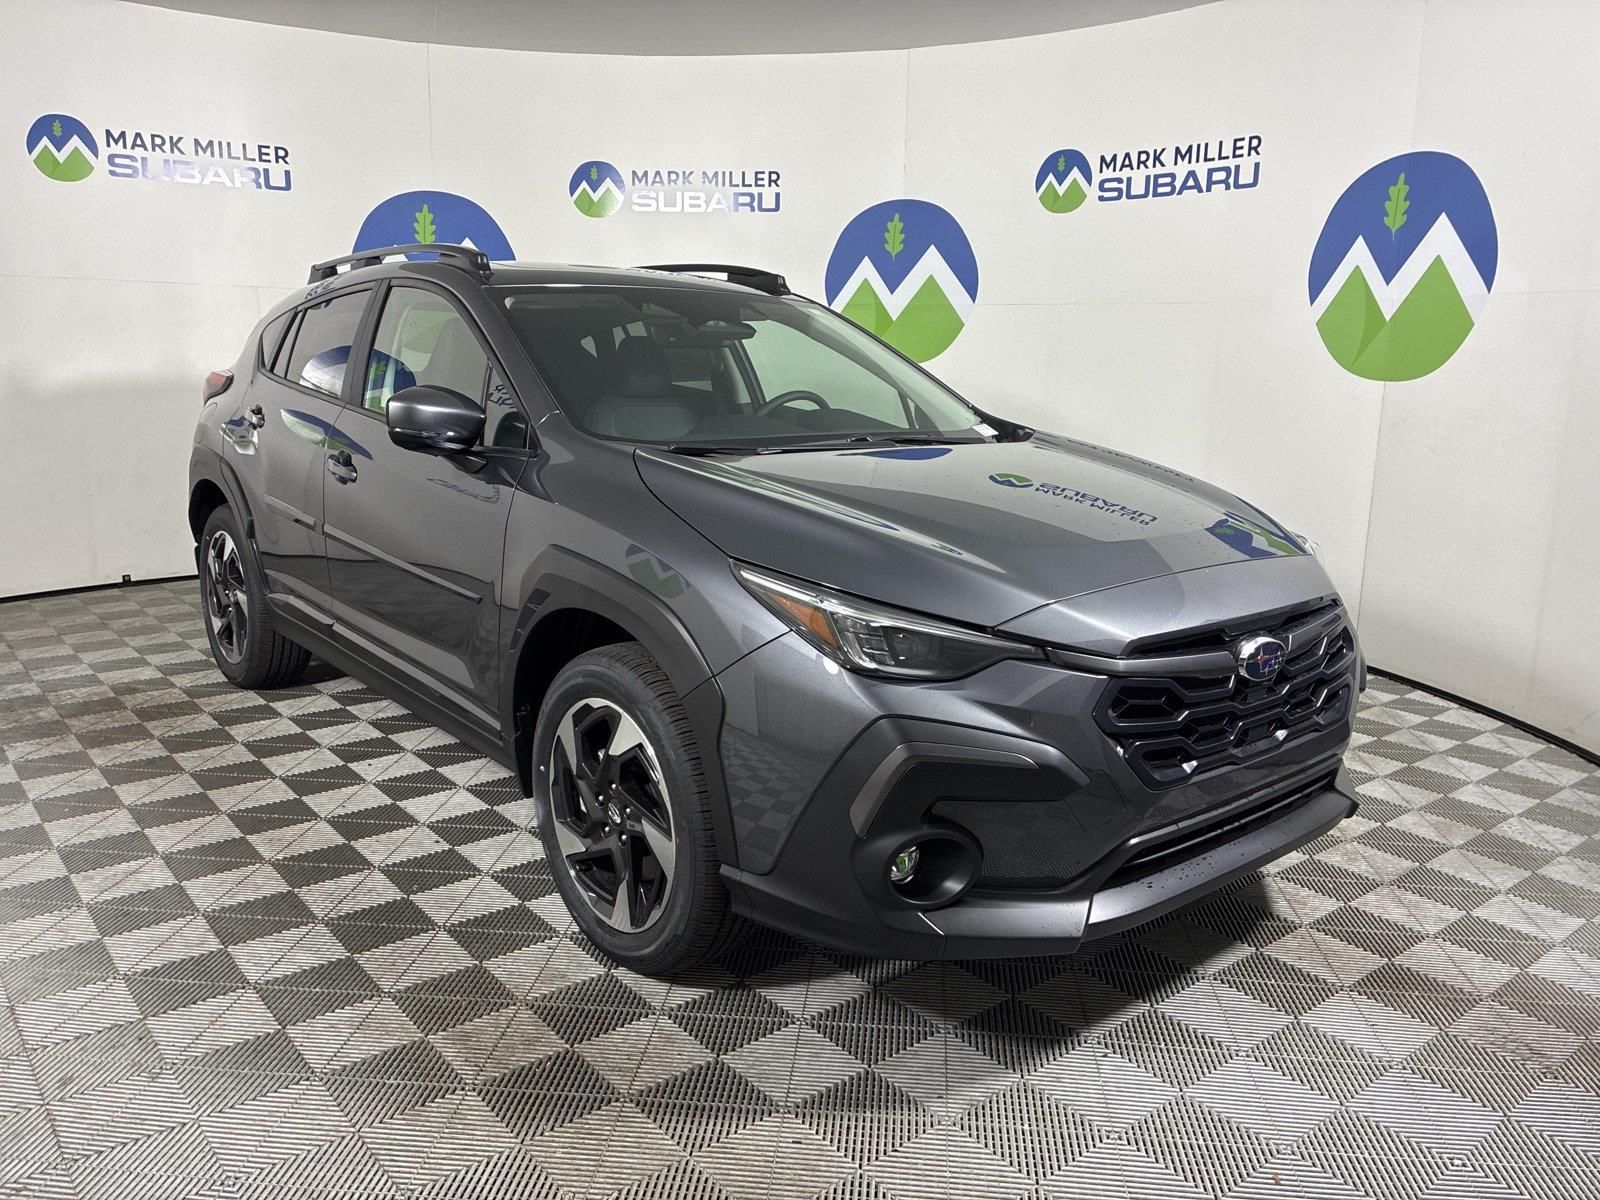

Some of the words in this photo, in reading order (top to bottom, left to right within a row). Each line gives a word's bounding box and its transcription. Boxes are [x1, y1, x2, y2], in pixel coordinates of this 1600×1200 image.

[105, 128, 184, 155] MARK
[194, 138, 289, 164] MILLER
[1099, 147, 1167, 173] MARK
[1173, 135, 1262, 166] MILLER
[108, 153, 292, 191] SUBARU
[631, 170, 694, 187] MARK
[702, 170, 780, 188] MILLER
[1098, 162, 1260, 202] SUBARU
[631, 190, 781, 213] SUBARU
